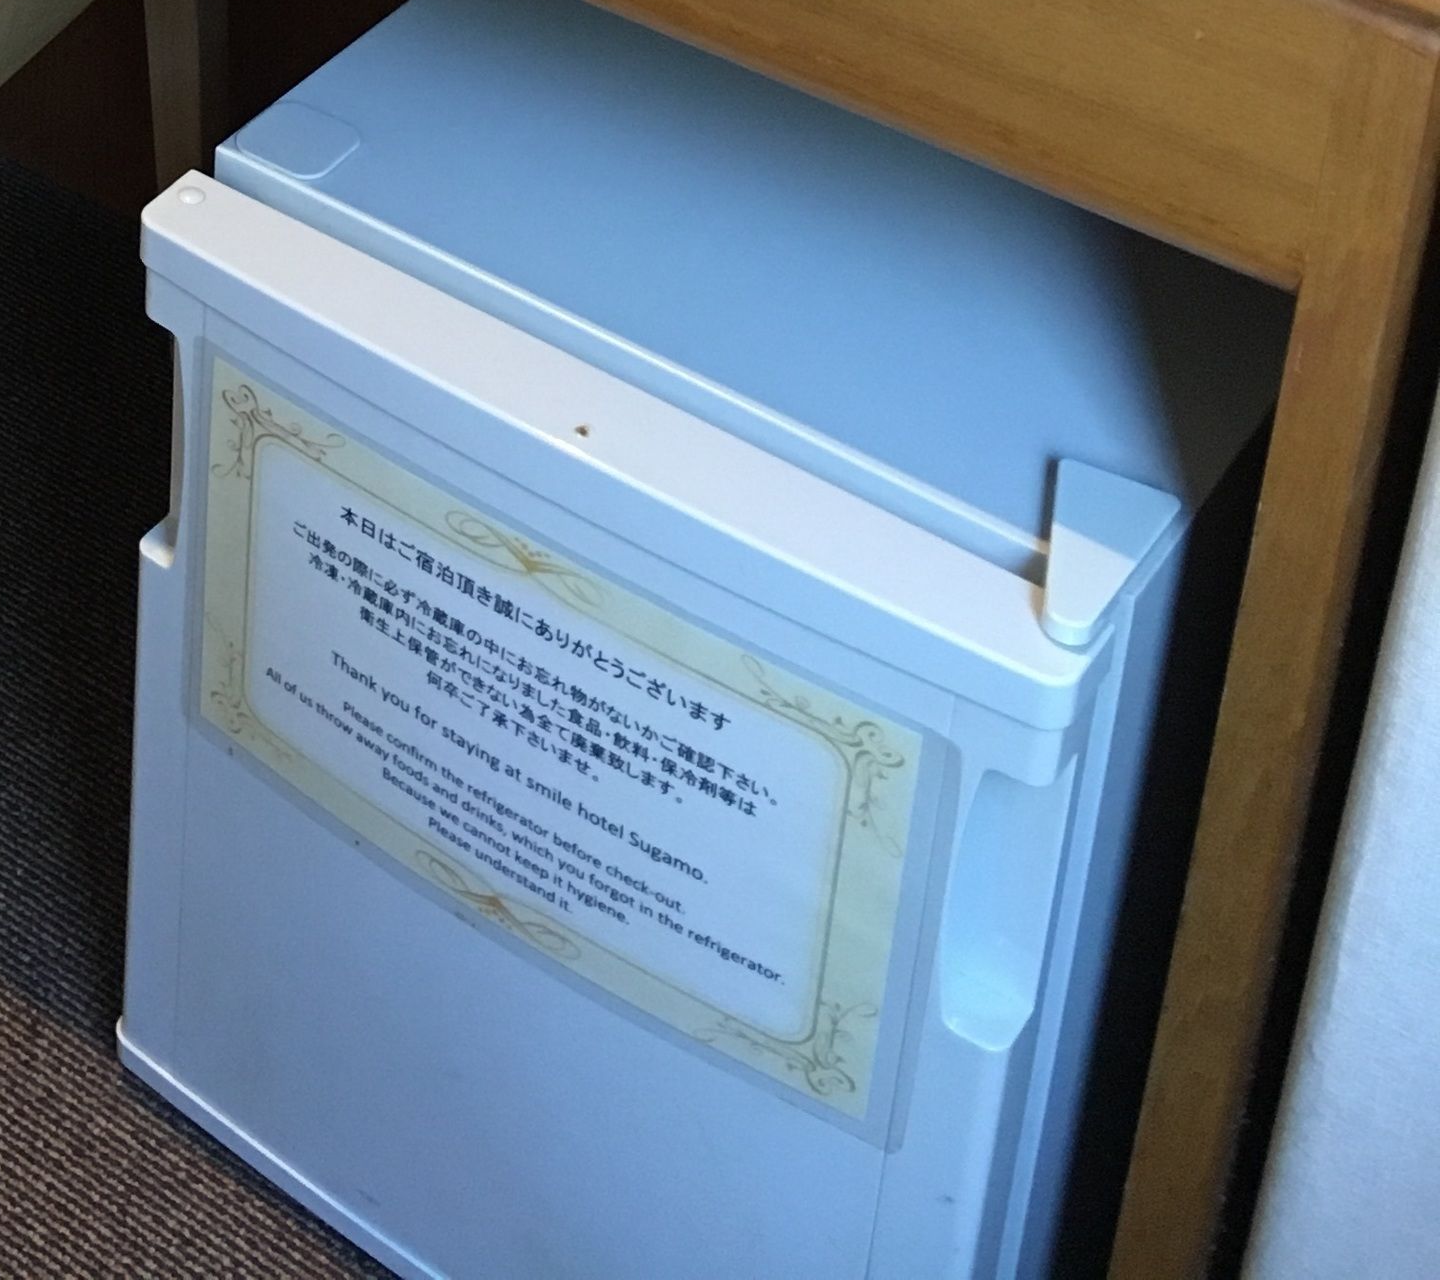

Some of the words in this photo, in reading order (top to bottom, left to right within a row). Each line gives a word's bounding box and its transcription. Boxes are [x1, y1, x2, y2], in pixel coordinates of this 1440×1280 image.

[293, 520, 777, 806] ご出発の際に必ず冷蔵庫の中にお忘れ物がないかご確認下さい。
[340, 505, 732, 731] 本日はご宿泊頂き誠にありがとうございます
[426, 671, 599, 783] 何卒ご了承下さいませ。
[266, 666, 282, 685] All
[284, 680, 298, 696] of
[299, 693, 314, 708] us
[315, 702, 353, 735] throw
[356, 733, 390, 762] away
[392, 754, 430, 787] foods
[432, 781, 458, 804] and
[461, 799, 507, 836] drinks,
[512, 830, 554, 863] which
[557, 855, 585, 881] you
[588, 873, 636, 908] forgot
[639, 902, 654, 919] in
[657, 912, 684, 934] the
[687, 928, 785, 986] refrigerator.
[331, 650, 377, 691] Thank
[381, 687, 410, 713] you
[415, 706, 438, 729] for
[442, 725, 500, 772] staying
[505, 765, 522, 782] at
[527, 776, 572, 810] smile
[578, 802, 625, 839] hotel
[629, 830, 708, 885] Sugamo.
[343, 701, 384, 737] Please
[387, 733, 438, 772] confirm
[441, 766, 464, 789] the
[467, 784, 549, 839] refrigerator
[553, 832, 602, 870] before
[606, 864, 686, 915] check-out.
[382, 767, 437, 811] Because
[440, 807, 460, 826] we
[463, 821, 512, 858] cannot
[514, 852, 549, 880] keep
[553, 870, 563, 888] it
[567, 880, 630, 925] hygiene.
[428, 816, 472, 852] Please
[475, 848, 556, 904] understand
